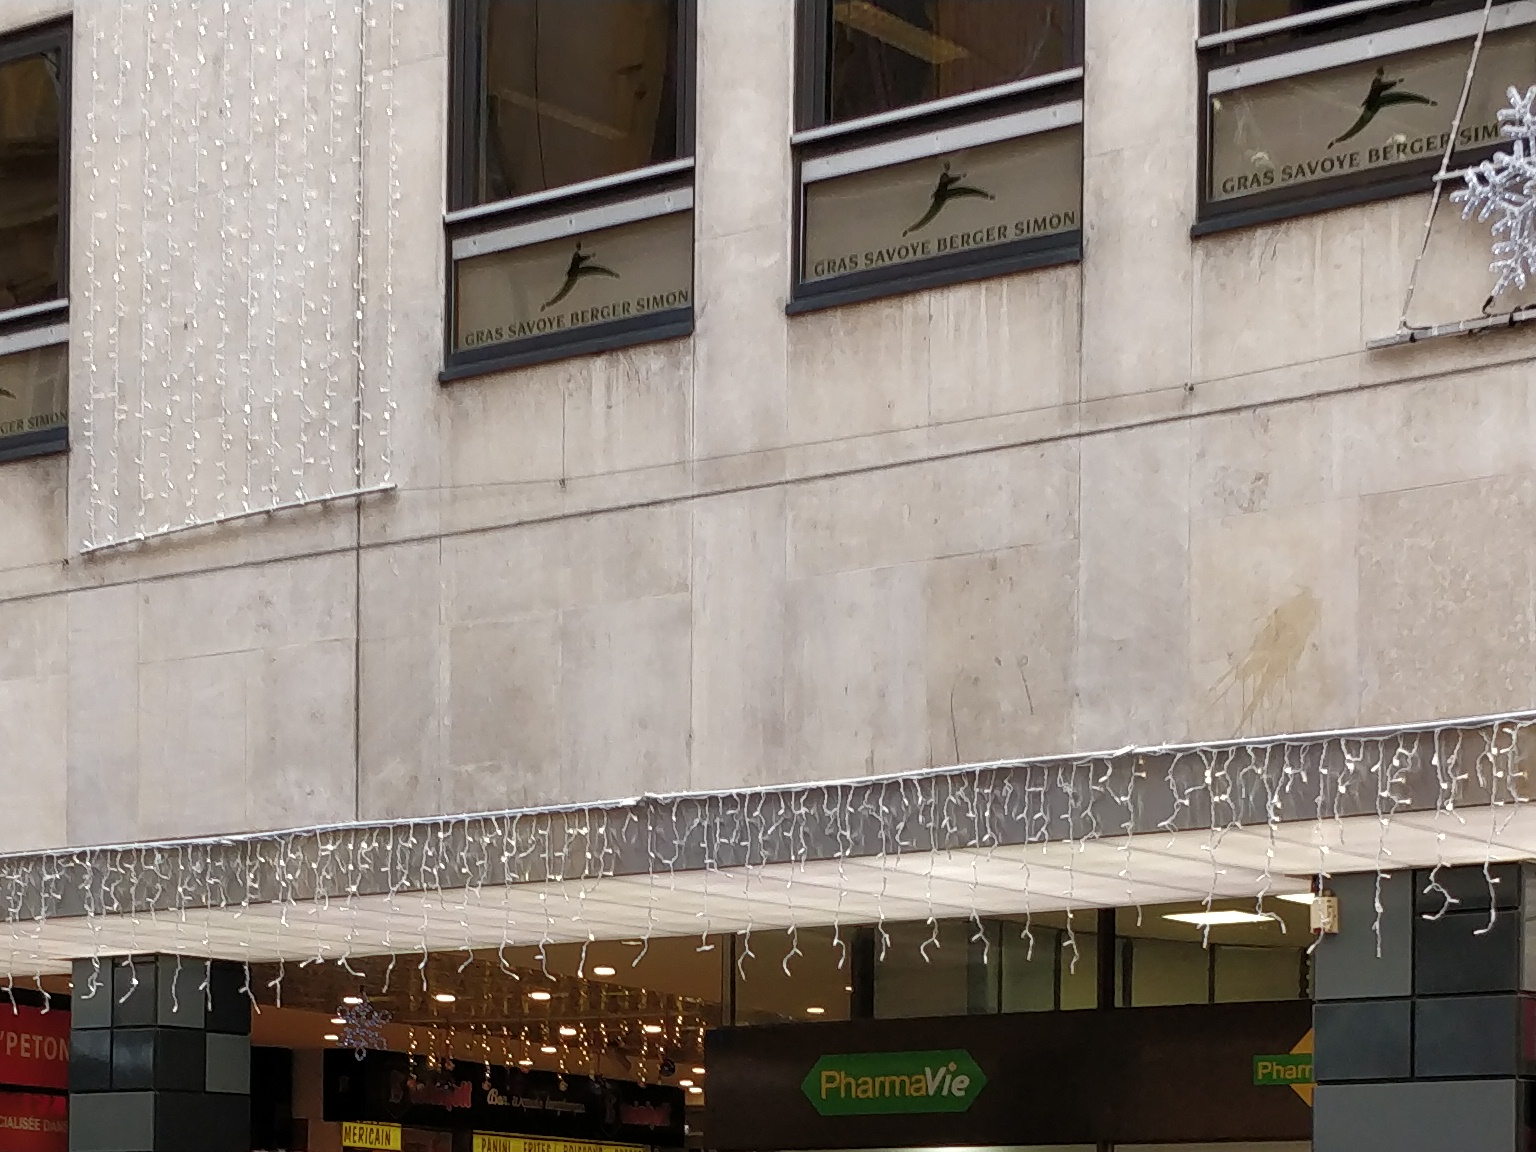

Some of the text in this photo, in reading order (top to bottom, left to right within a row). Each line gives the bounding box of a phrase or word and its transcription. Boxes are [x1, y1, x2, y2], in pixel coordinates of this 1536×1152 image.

[1222, 122, 1512, 194] GRAS SAVOYE BERGER SIM
[814, 210, 1076, 277] GRAS SAVOYE BERGER SIMON
[465, 290, 689, 347] GRAS SAVOYE BERGER SIMON
[27, 410, 68, 431] SIMON
[820, 1061, 971, 1100] PharmaVie
